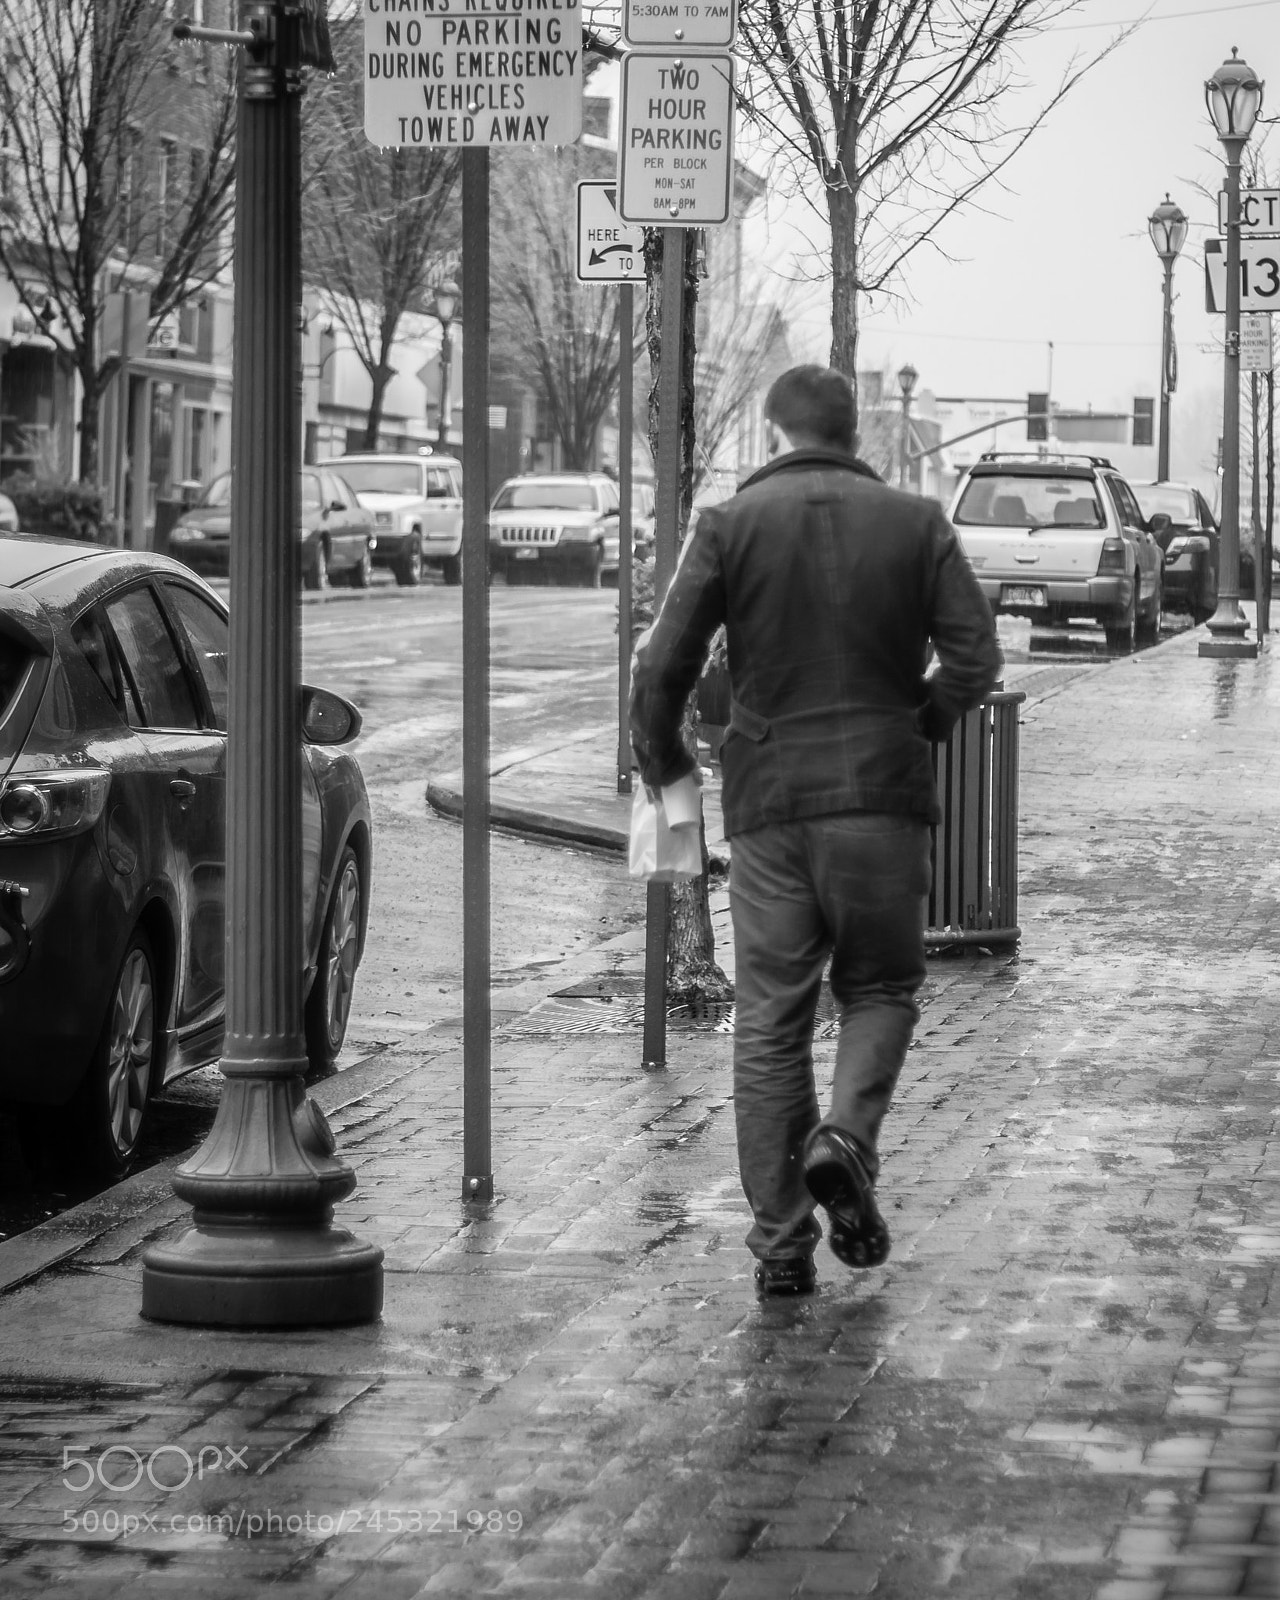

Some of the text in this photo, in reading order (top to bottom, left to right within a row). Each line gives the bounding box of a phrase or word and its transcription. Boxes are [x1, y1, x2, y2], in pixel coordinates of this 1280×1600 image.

[632, 5, 728, 17] 5:30AM TO 7AM
[386, 18, 561, 46] NO PARKING
[369, 50, 578, 78] DURING EMERGENCY
[658, 69, 700, 90] TWO
[423, 83, 524, 110] VEHICLES
[648, 98, 706, 120] HOUR
[399, 115, 549, 143] TOWED AWAY
[631, 128, 722, 150] PARKING
[644, 158, 707, 170] PER BLOCK
[655, 178, 695, 190] MON-SAT
[653, 197, 696, 210] 8AM-8PM
[1223, 197, 1279, 226] CT
[588, 229, 620, 241] HERE
[619, 258, 633, 270] TO
[1223, 257, 1280, 298] 13
